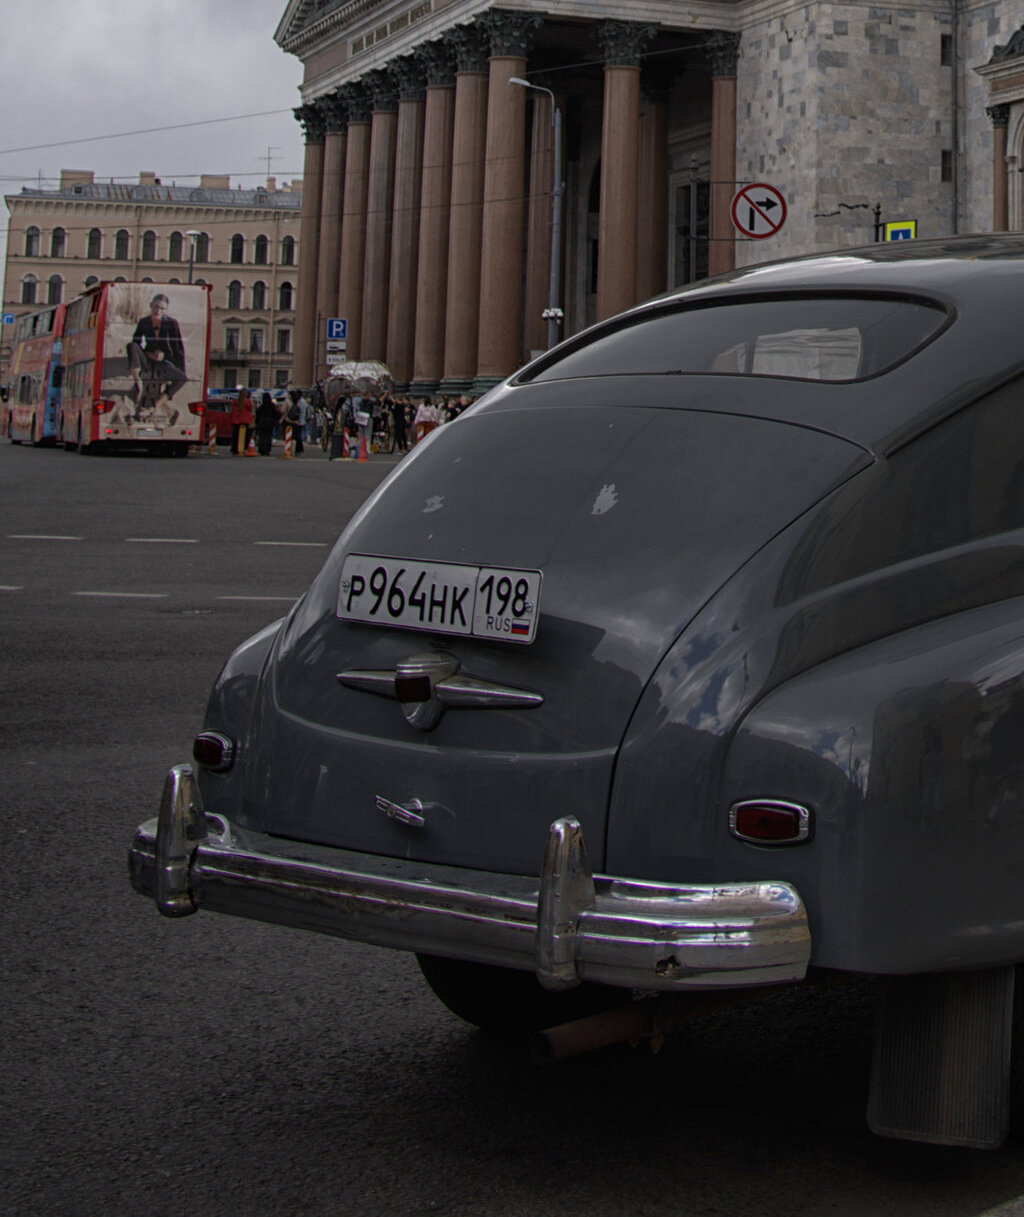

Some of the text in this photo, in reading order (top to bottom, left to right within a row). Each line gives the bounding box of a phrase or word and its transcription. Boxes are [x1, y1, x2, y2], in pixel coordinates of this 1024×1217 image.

[332, 321, 344, 337] P
[347, 567, 528, 626] Р964НК 198
[486, 616, 511, 632] RUS
